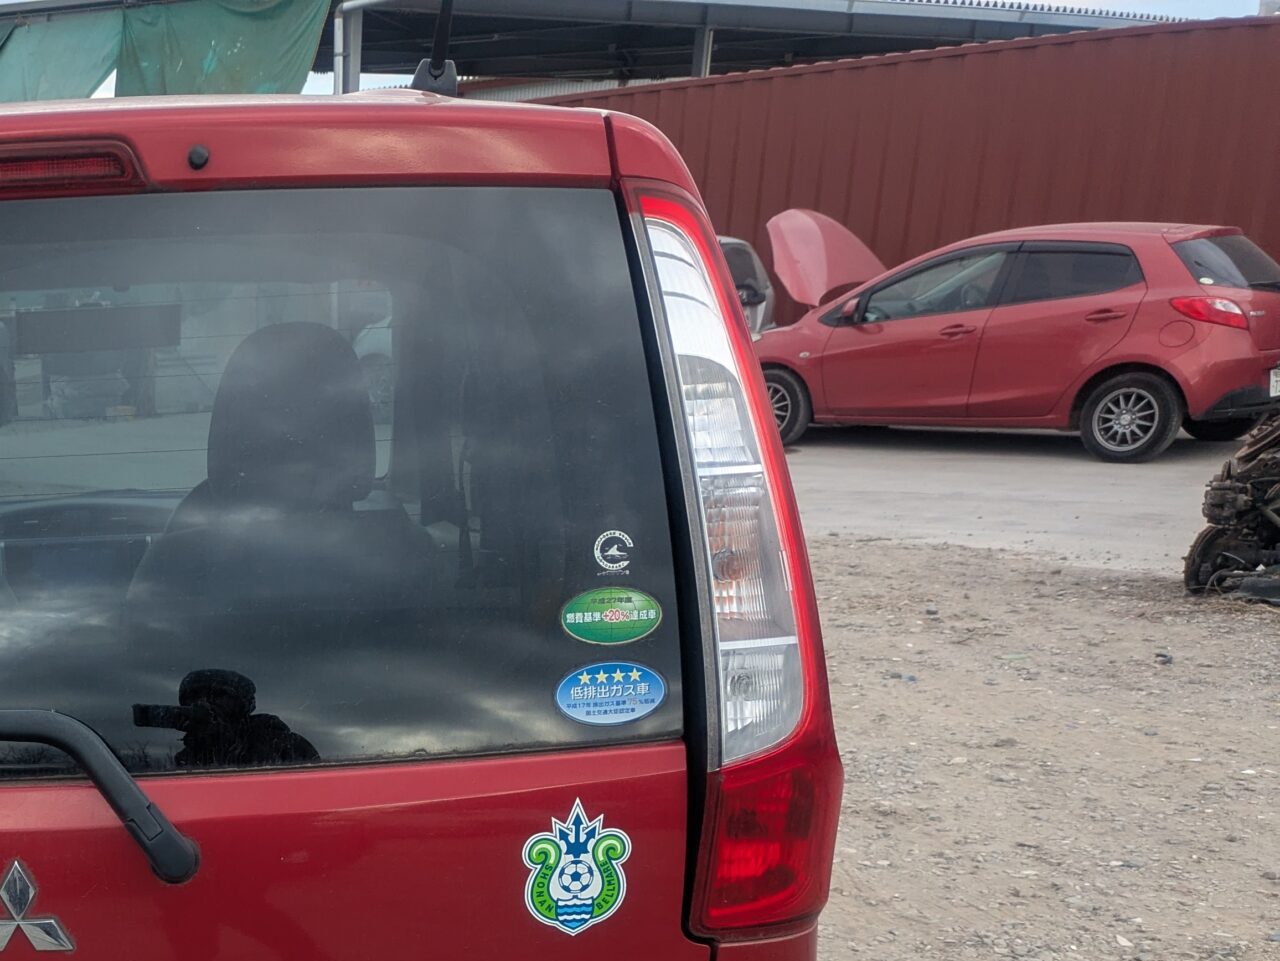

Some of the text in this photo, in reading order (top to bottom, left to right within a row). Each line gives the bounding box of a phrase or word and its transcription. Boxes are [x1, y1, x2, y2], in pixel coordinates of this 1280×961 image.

[571, 683, 649, 700] 低排出ガス車
[536, 864, 554, 913] SHONAN
[596, 861, 615, 910] BELLMARE
